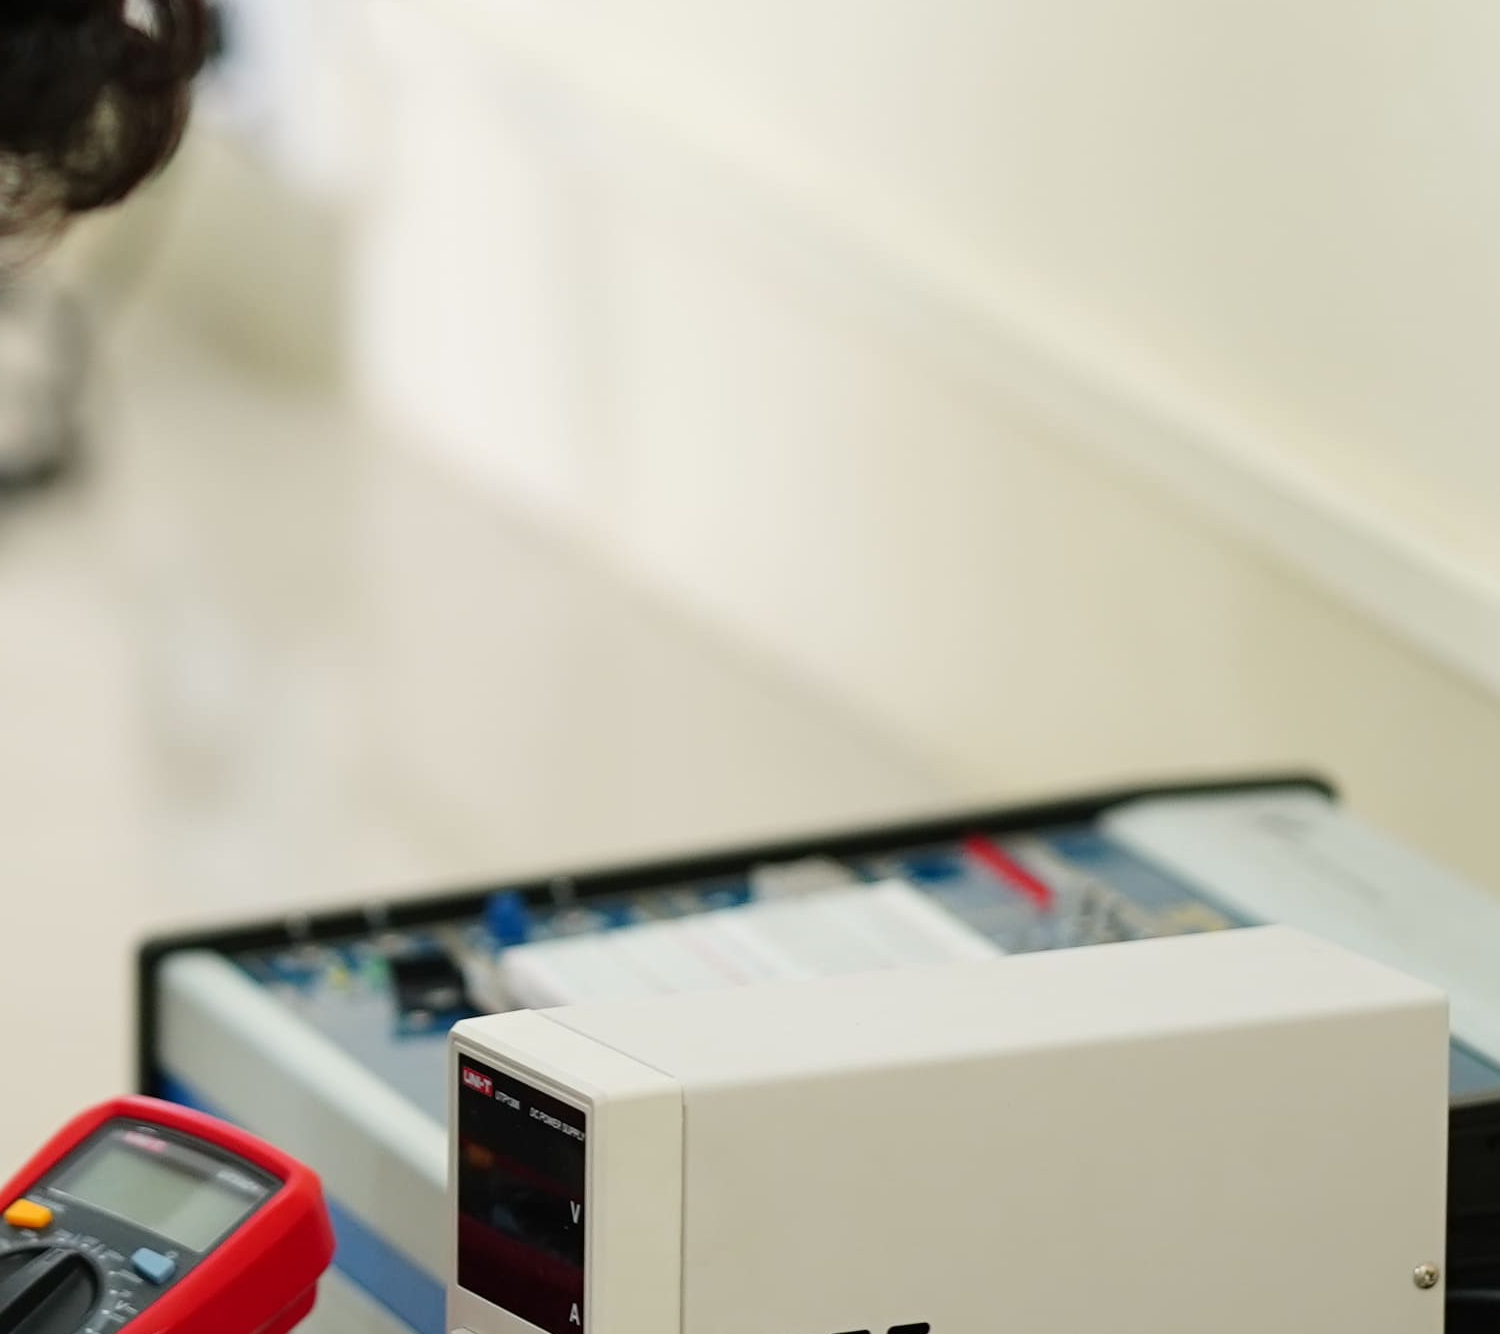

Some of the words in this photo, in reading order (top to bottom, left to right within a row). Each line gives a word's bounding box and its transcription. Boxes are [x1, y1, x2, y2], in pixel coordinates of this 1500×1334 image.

[463, 1069, 493, 1094] UNI-T
[540, 1111, 562, 1131] POWER
[562, 1122, 585, 1142] SUPPLY
[570, 1200, 581, 1224] V
[569, 1302, 581, 1327] A
